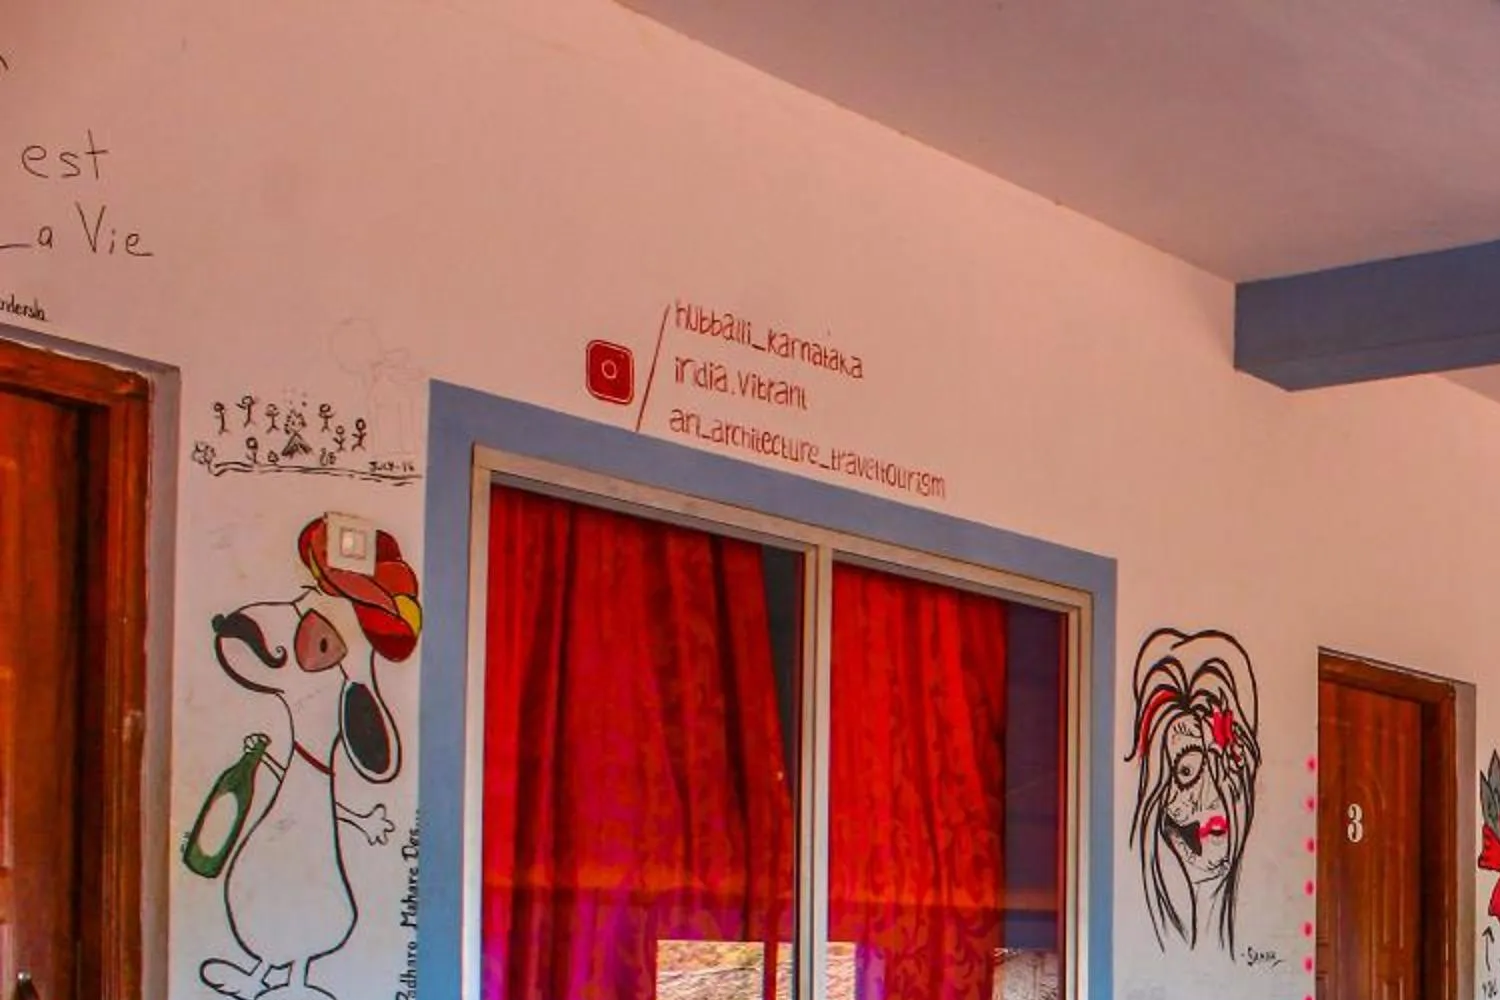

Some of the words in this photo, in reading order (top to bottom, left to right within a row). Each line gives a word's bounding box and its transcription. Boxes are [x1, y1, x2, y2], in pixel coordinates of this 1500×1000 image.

[21, 129, 109, 180] est
[75, 201, 154, 257] Vie
[1347, 803, 1364, 843] 3
